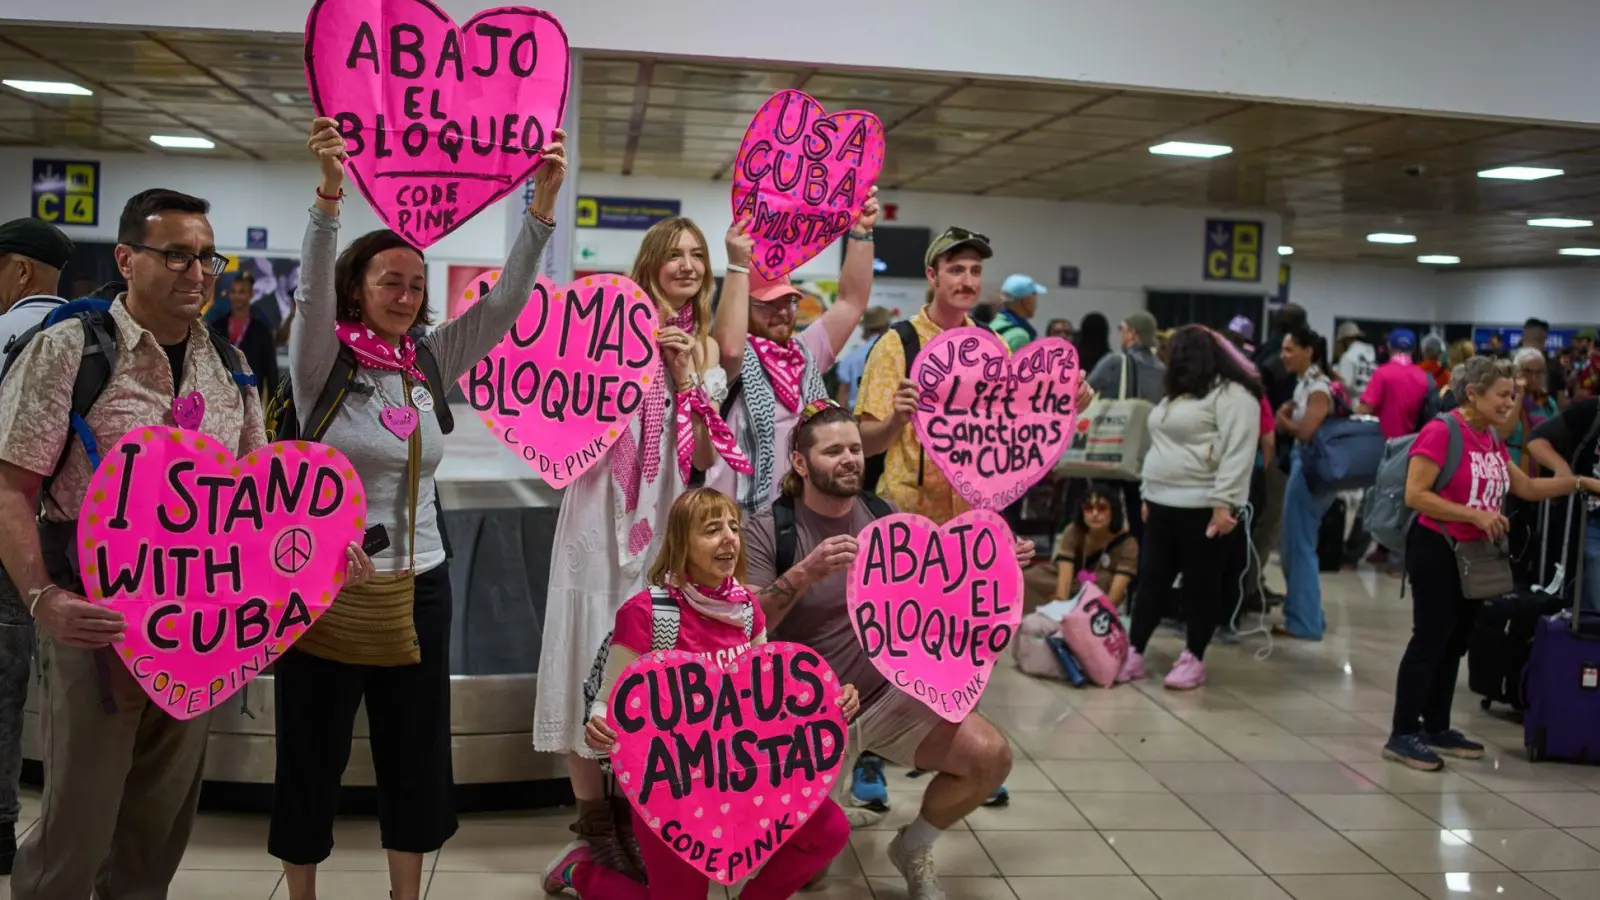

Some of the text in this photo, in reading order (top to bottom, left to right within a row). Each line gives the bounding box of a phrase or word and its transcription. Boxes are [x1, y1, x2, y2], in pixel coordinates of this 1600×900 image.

[346, 21, 537, 82] ABAJO
[404, 86, 447, 120] EL
[774, 93, 867, 167] USA
[335, 112, 544, 164] BLOQUEO
[396, 182, 460, 207] CODE
[743, 140, 856, 208] CUBA
[37, 193, 86, 221] C 4
[398, 208, 459, 233] PINK
[736, 182, 852, 246] AMISTAD
[1208, 250, 1250, 278] C 4
[480, 281, 654, 369] O MAS
[468, 356, 643, 422] BLOQUEO
[944, 375, 1071, 419] Lift the
[1007, 347, 1074, 393] heart
[504, 428, 608, 480] CODEPINK
[927, 415, 1061, 452] Sanctions
[950, 443, 1044, 478] on CUBA
[108, 444, 343, 534] I STAND
[96, 543, 241, 598] WITH
[863, 521, 996, 594] ABAJO
[147, 591, 312, 653] CUBA
[971, 579, 1010, 617] EL
[856, 599, 1011, 667] BLOQUEO
[133, 644, 279, 714] CODEPINK
[613, 651, 827, 733] CUBA-U.S.
[638, 719, 844, 805] AMISTAD
